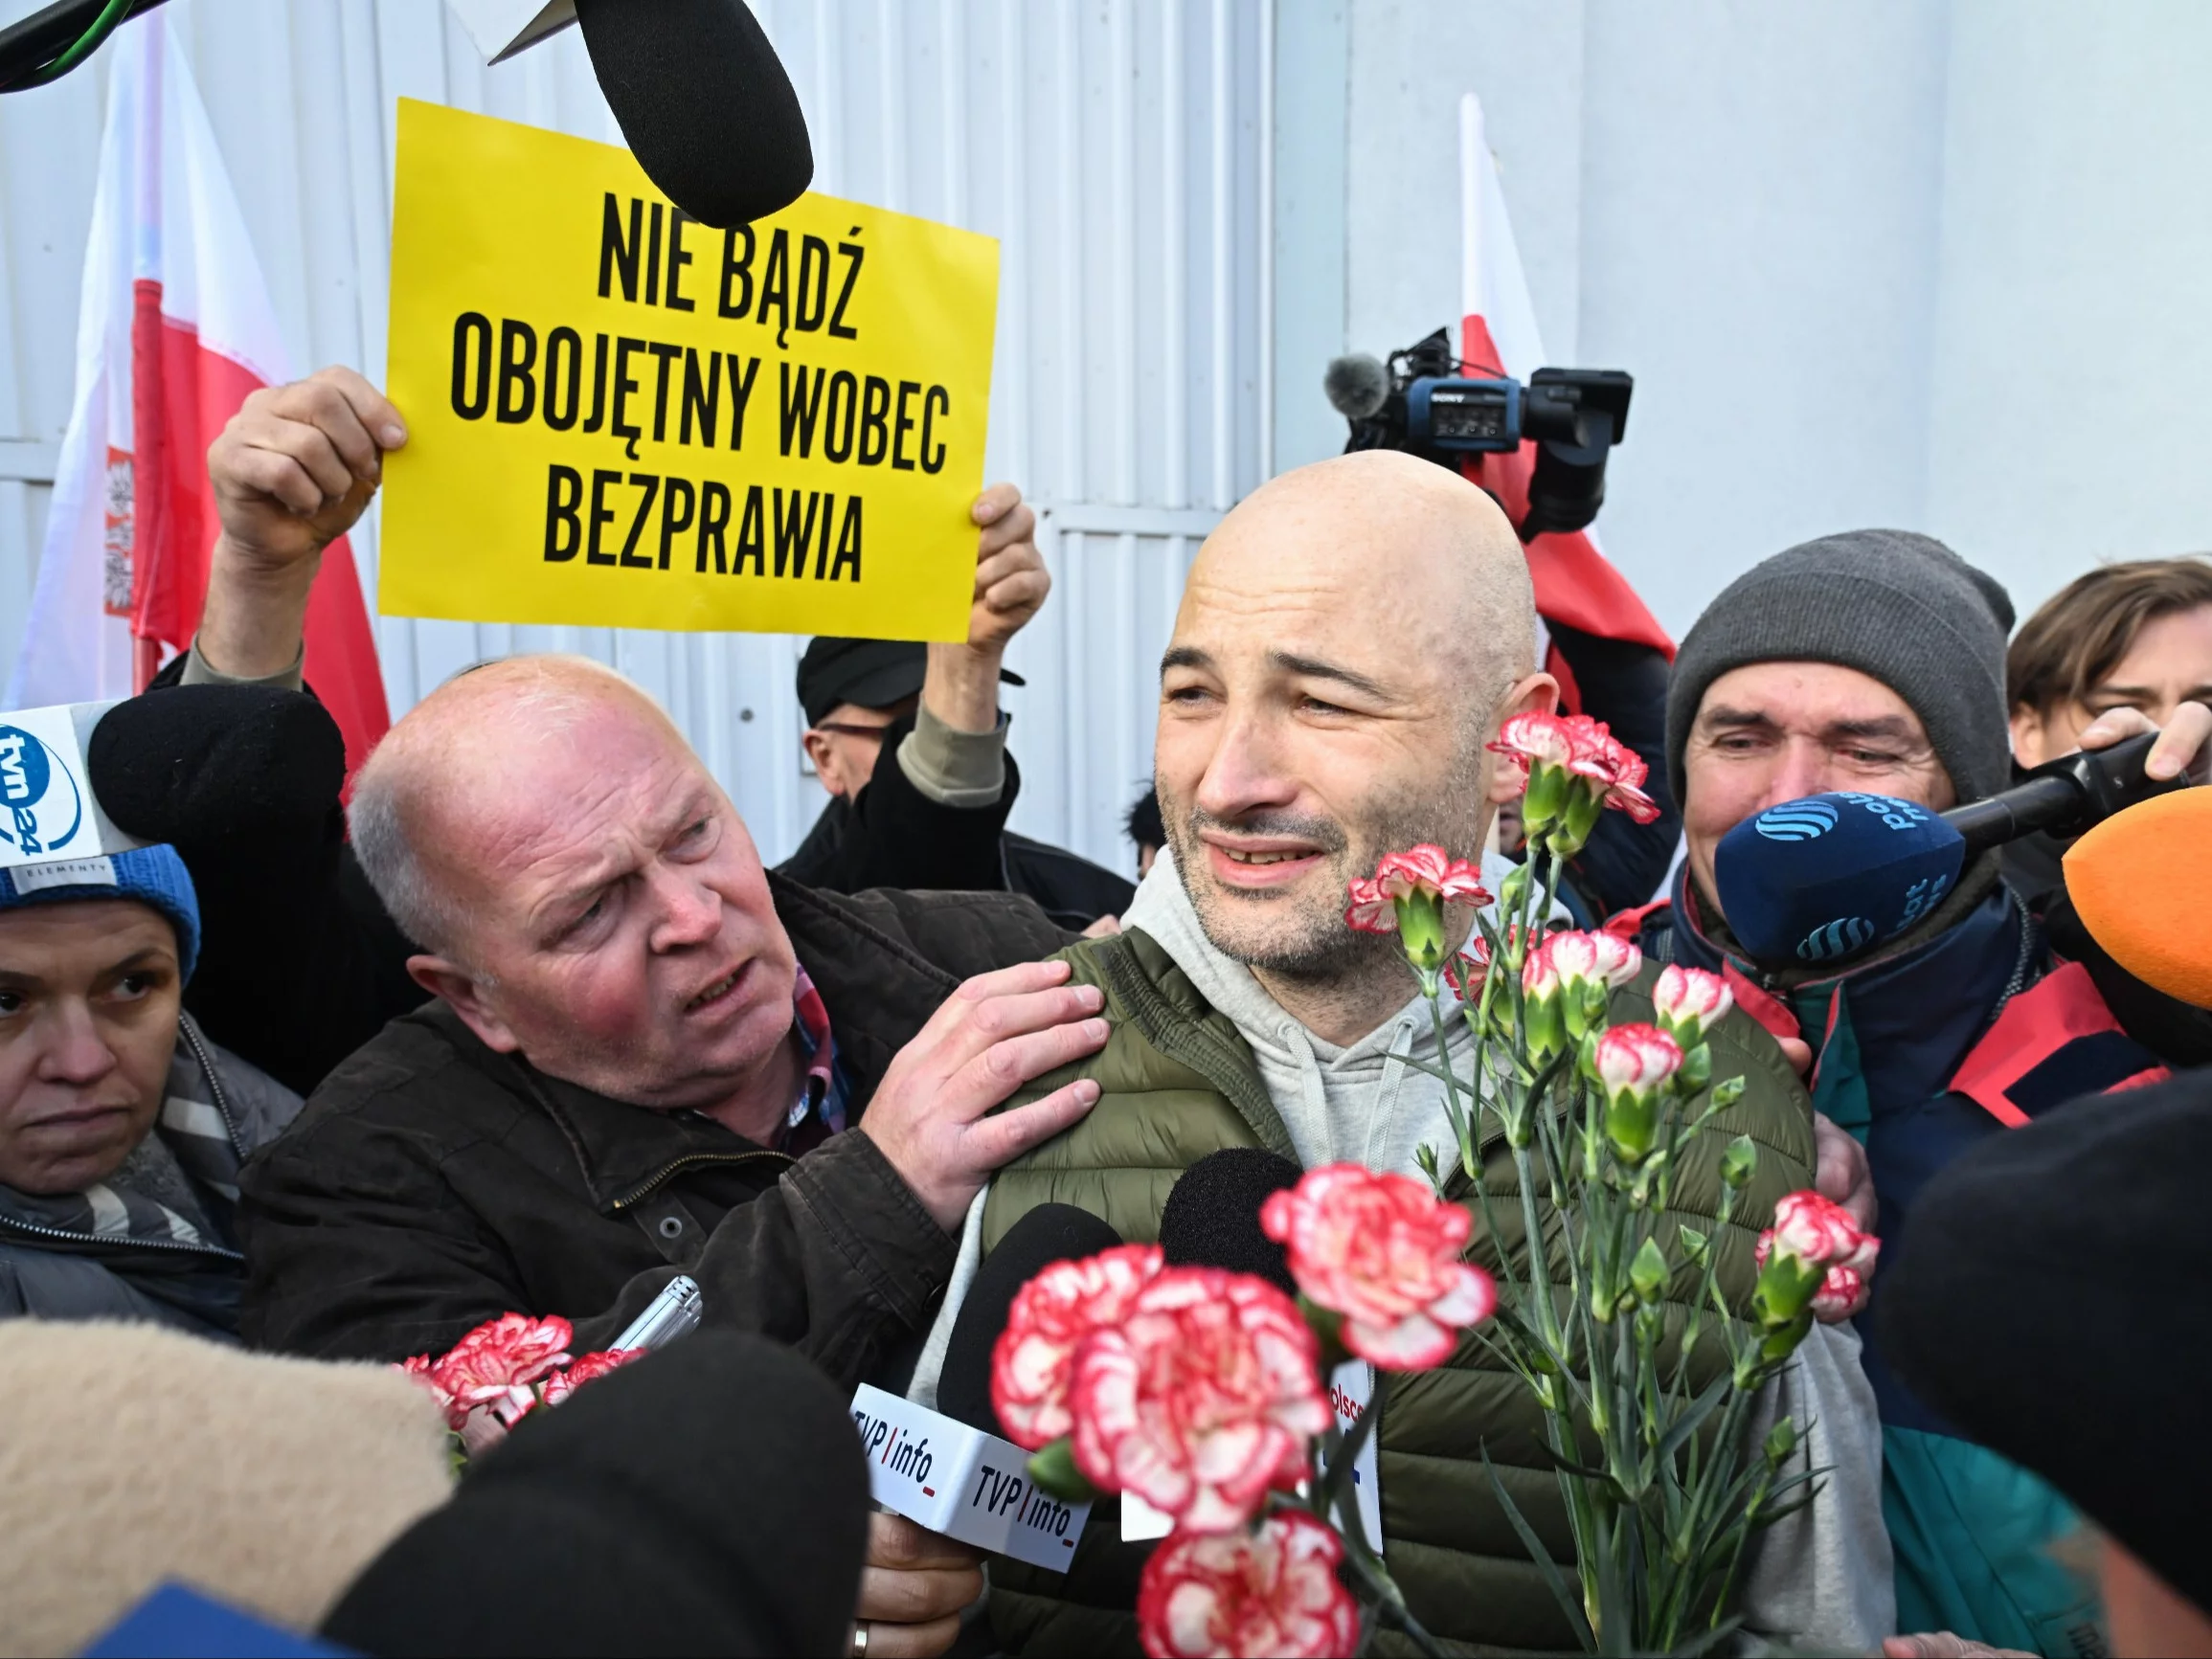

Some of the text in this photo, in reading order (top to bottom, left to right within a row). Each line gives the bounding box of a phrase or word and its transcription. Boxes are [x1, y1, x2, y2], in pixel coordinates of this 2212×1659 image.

[597, 191, 866, 349] NIE BĄDŹ
[450, 311, 950, 475] OBOJĘTNY WOBEC
[543, 463, 864, 583] BEZPRAWIA
[26, 864, 106, 877] ELEMENTY
